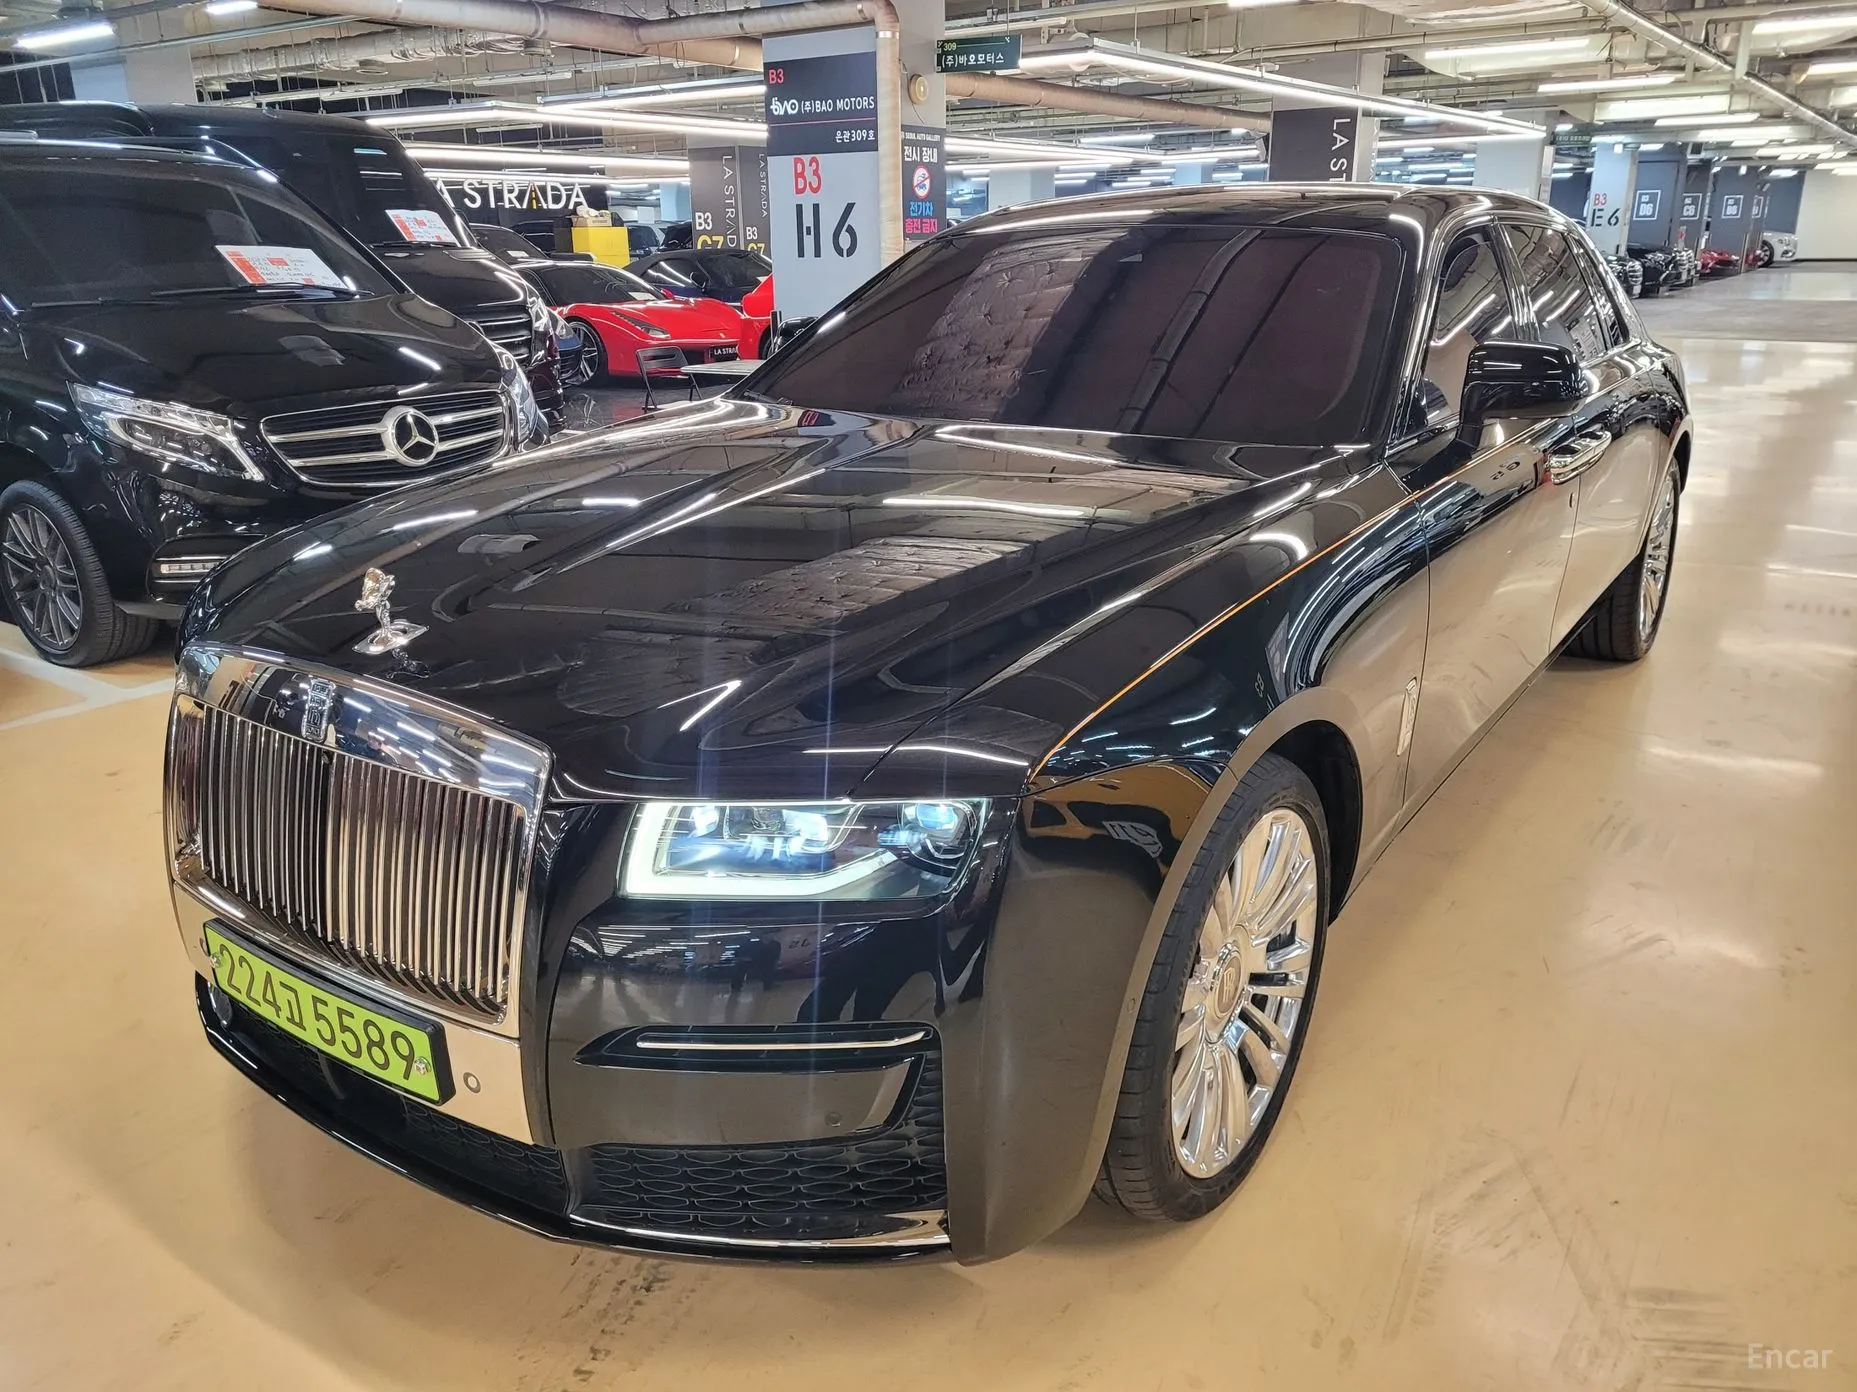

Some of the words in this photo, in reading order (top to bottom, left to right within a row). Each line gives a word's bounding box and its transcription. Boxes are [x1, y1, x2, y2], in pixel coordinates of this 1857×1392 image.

[942, 42, 957, 51] 309
[942, 52, 1005, 68] (주)바오모터스
[768, 69, 784, 84] B3
[836, 96, 875, 111] MOTORS
[1332, 118, 1351, 151] LA
[759, 153, 765, 168] LA
[904, 146, 920, 162] 전시
[922, 147, 938, 163] 장내
[723, 155, 733, 179] LA
[793, 155, 822, 195] B3
[1329, 157, 1348, 182] ST
[463, 179, 588, 210] STRADA
[760, 171, 768, 217] STRADA
[1593, 193, 1608, 206] B3
[724, 185, 737, 248] STRAD
[910, 201, 933, 217] 전기차
[1591, 208, 1605, 227] E
[1607, 208, 1621, 226] 6
[695, 212, 712, 230] B3
[832, 202, 858, 258] 6
[922, 219, 938, 234] 금지
[746, 227, 758, 239] B3
[219, 943, 307, 1032] 224고
[311, 995, 415, 1081] 5589
